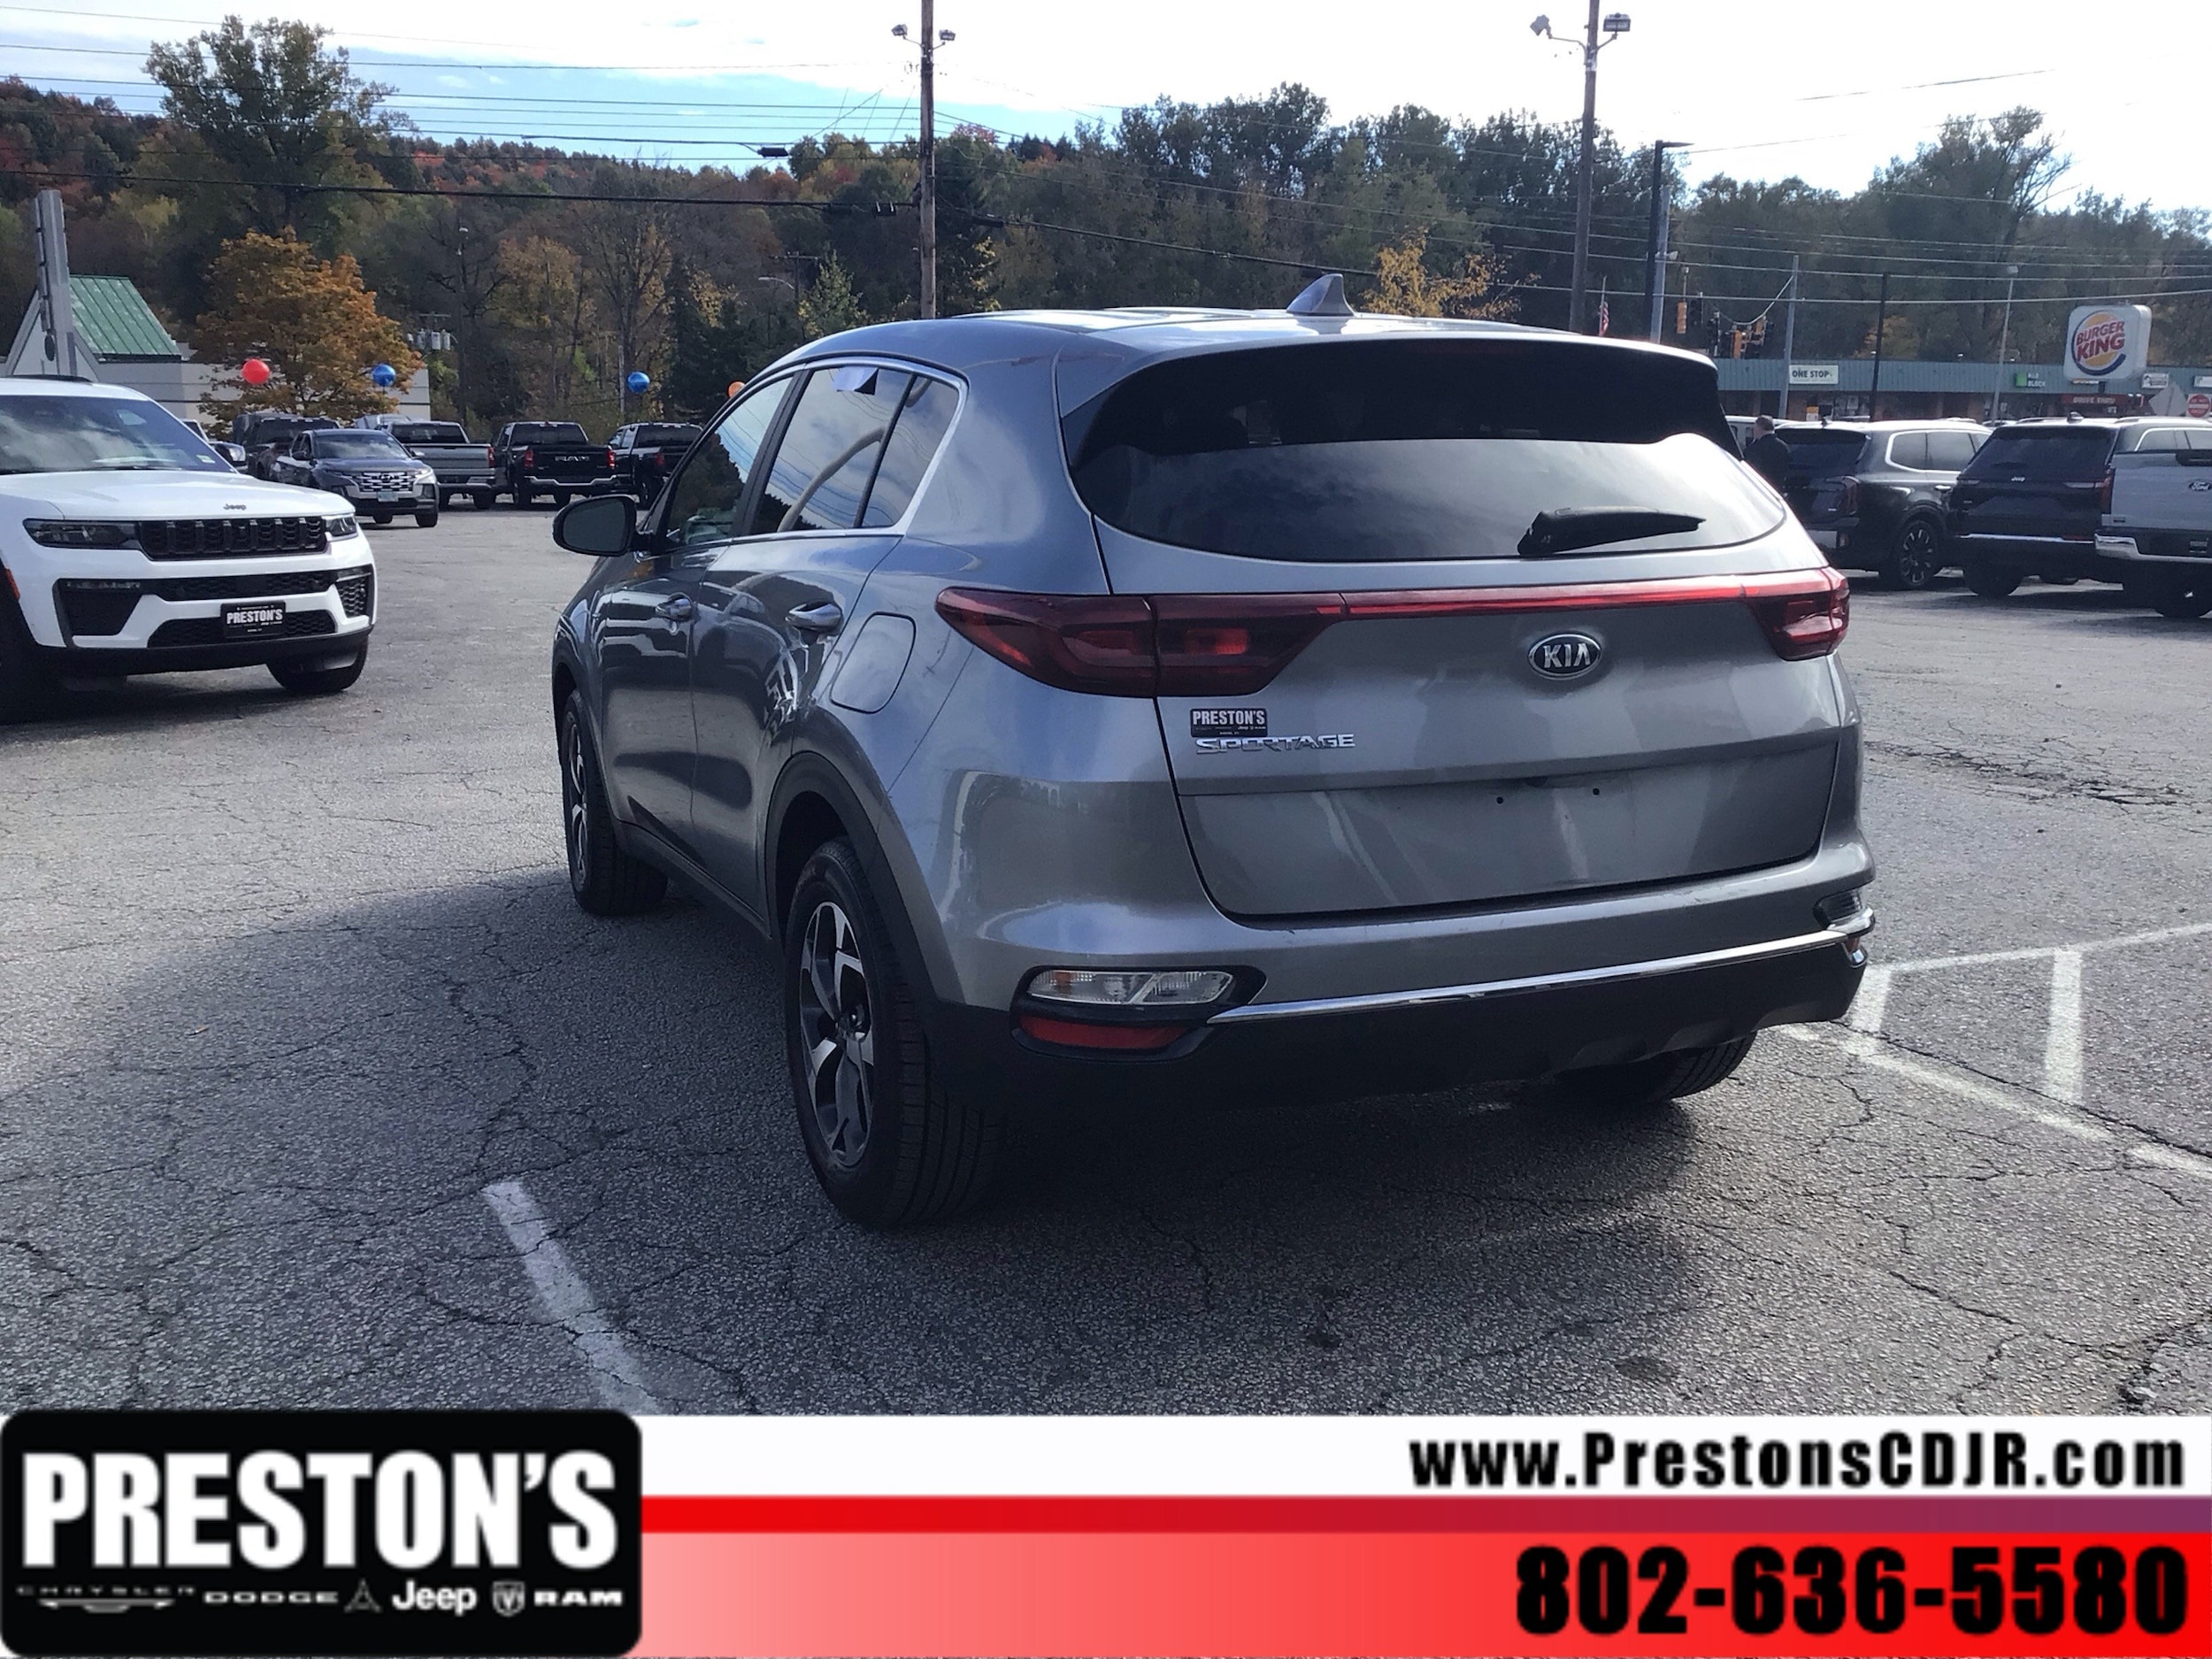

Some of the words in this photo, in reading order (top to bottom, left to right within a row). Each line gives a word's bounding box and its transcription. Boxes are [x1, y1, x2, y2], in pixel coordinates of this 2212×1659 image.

[2076, 320, 2125, 346] BURGER
[2076, 333, 2125, 363] KING
[227, 609, 283, 624] PRESTON'S
[1543, 642, 1591, 668] KIA
[1193, 710, 1266, 726] PRESTON'S
[1196, 733, 1356, 754] SPORTAGE
